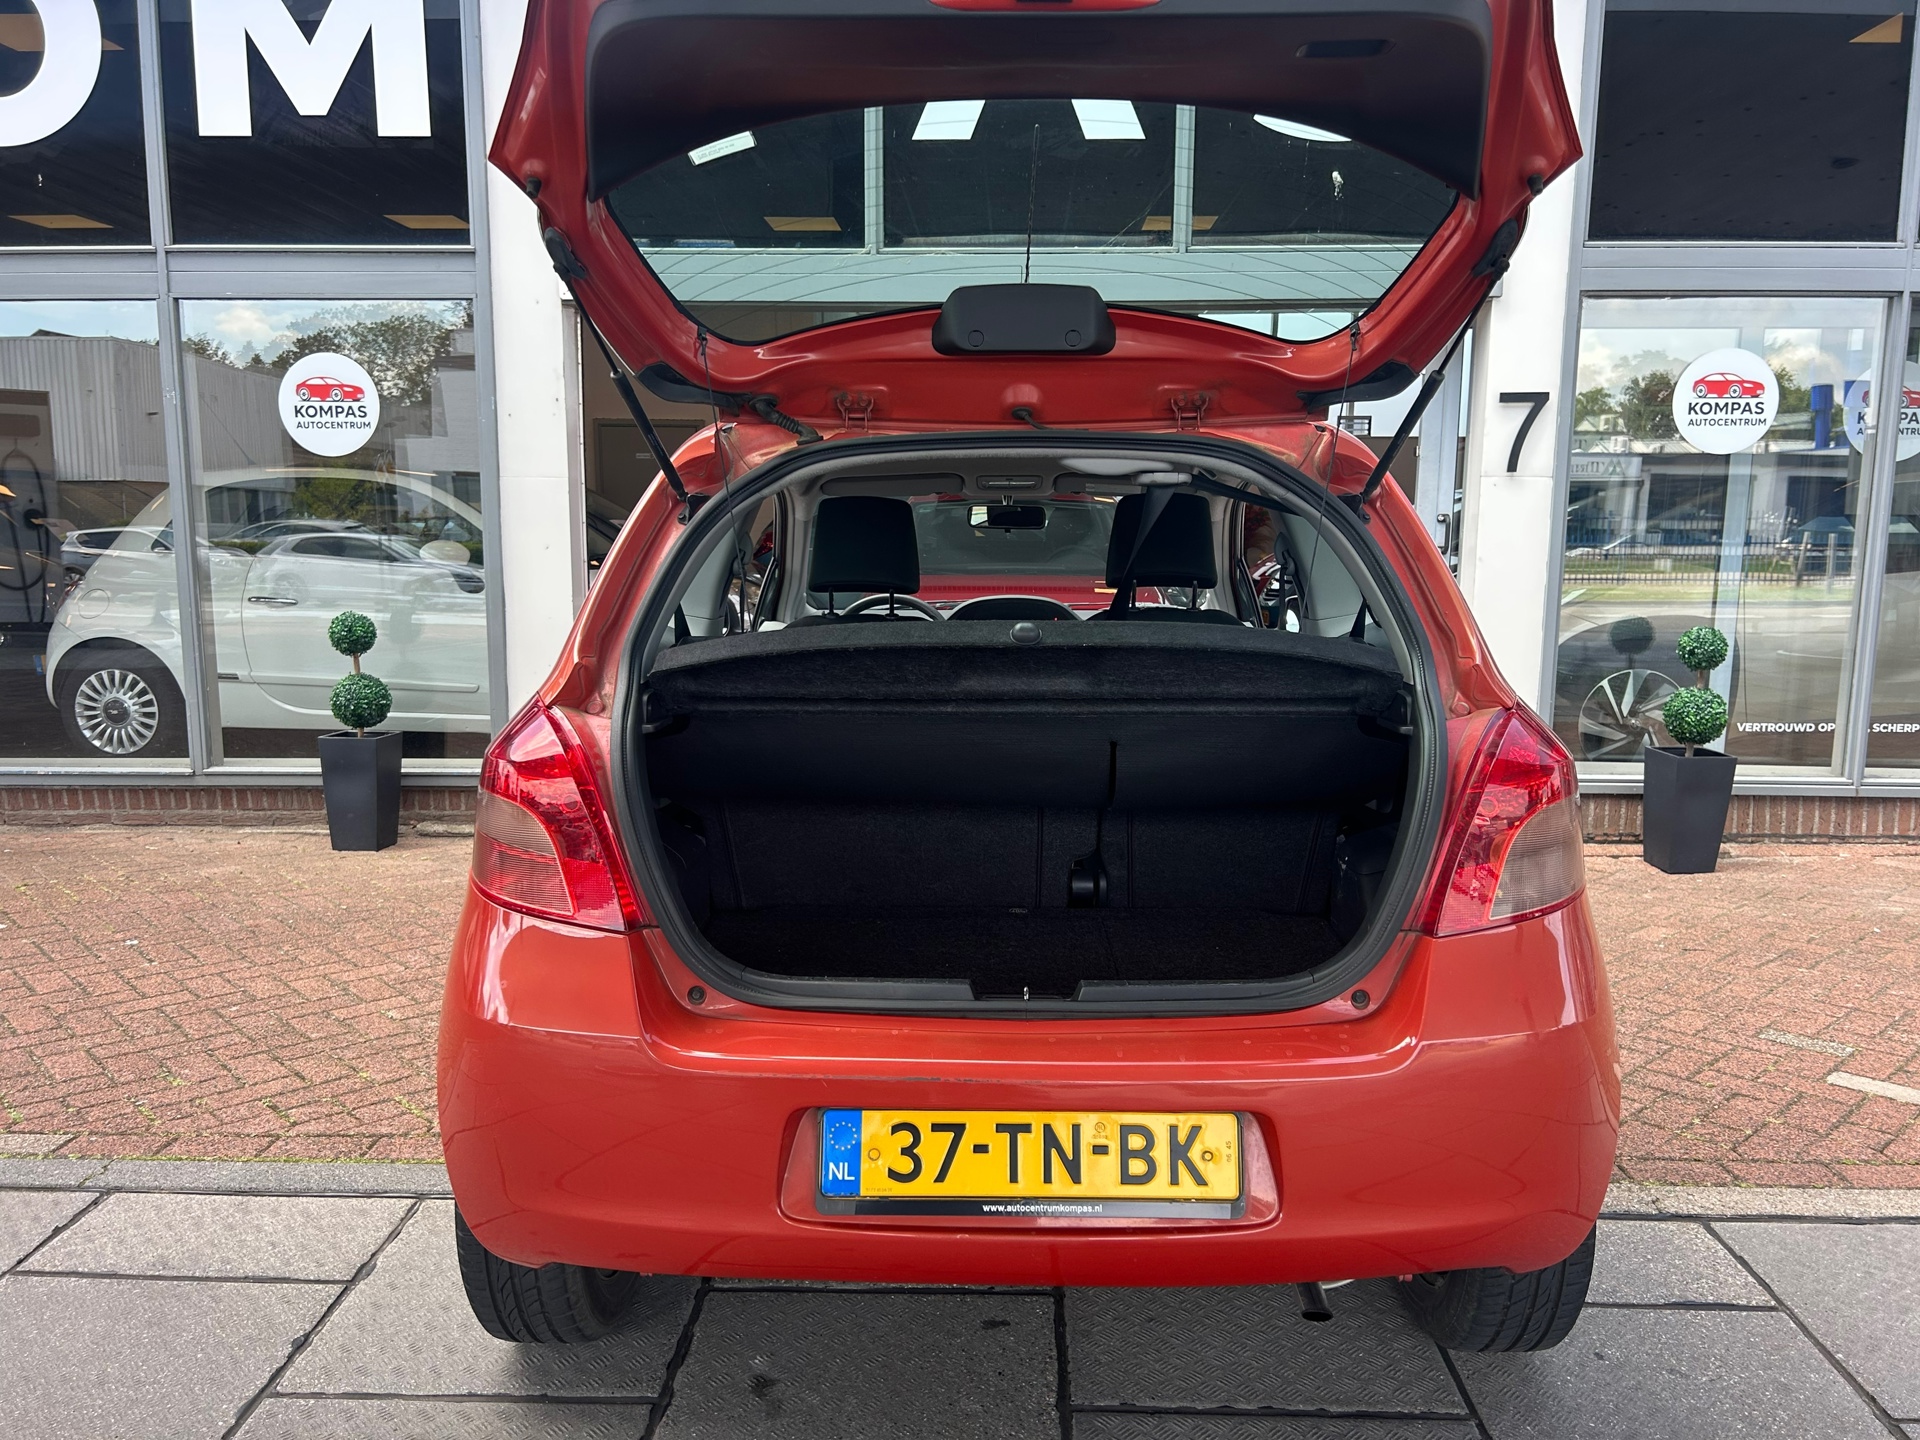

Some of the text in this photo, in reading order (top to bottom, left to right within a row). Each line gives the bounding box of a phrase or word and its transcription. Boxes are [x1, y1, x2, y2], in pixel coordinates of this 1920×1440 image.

[294, 405, 368, 418] KOMPAS
[1687, 402, 1765, 415] KOMPAS
[296, 421, 371, 429] AUTOCENTRUM
[1688, 418, 1767, 427] AUTOCENTRUM
[1499, 392, 1549, 472] 7
[1737, 722, 1815, 732] VERTROUWD
[1872, 723, 1920, 733] SCHERP
[887, 1122, 1208, 1186] 37-TN-BK
[828, 1162, 855, 1180] NL
[982, 1203, 1103, 1214] www.autocentrumkompas.nl
